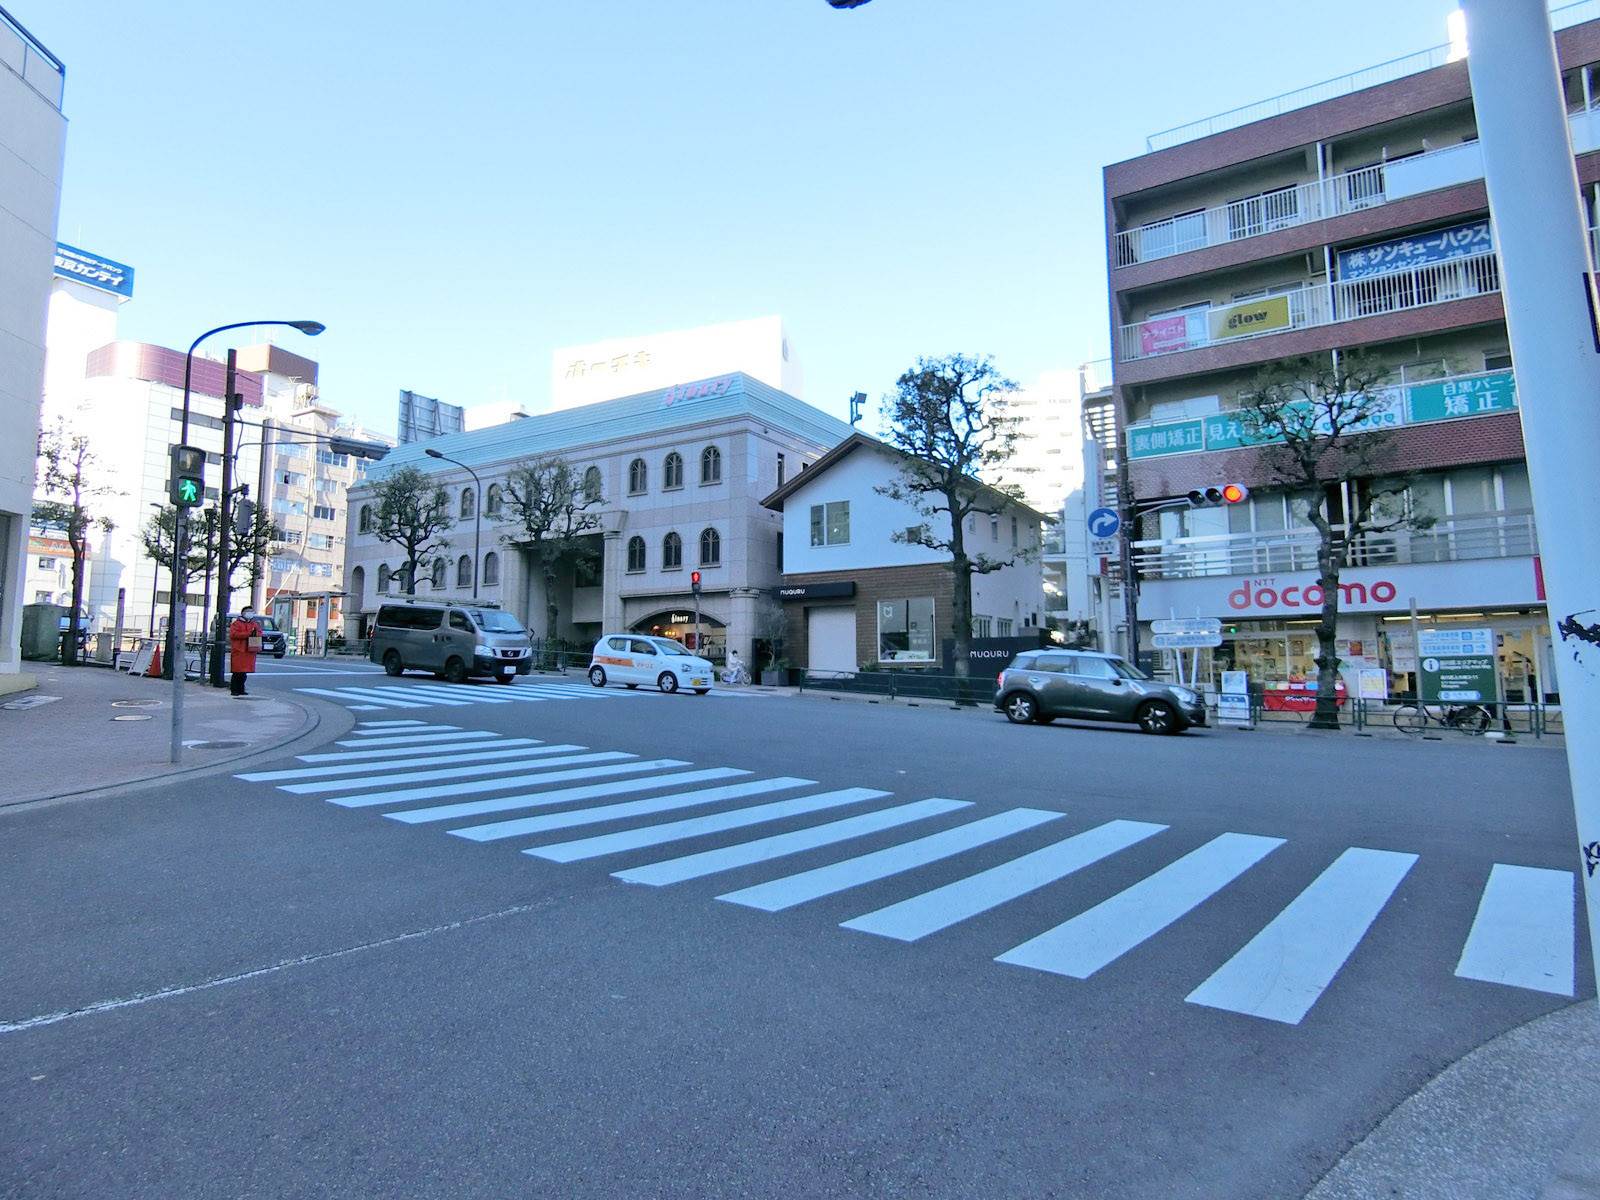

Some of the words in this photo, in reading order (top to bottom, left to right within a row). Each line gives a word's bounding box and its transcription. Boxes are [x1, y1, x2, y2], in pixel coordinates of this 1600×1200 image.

[1228, 311, 1268, 329] glow
[565, 350, 651, 379] ホーチキ
[1135, 427, 1202, 451] 裏側矯正
[1254, 578, 1276, 587] NTT
[1228, 580, 1397, 610] docomo
[970, 650, 1009, 658] MUQURU
